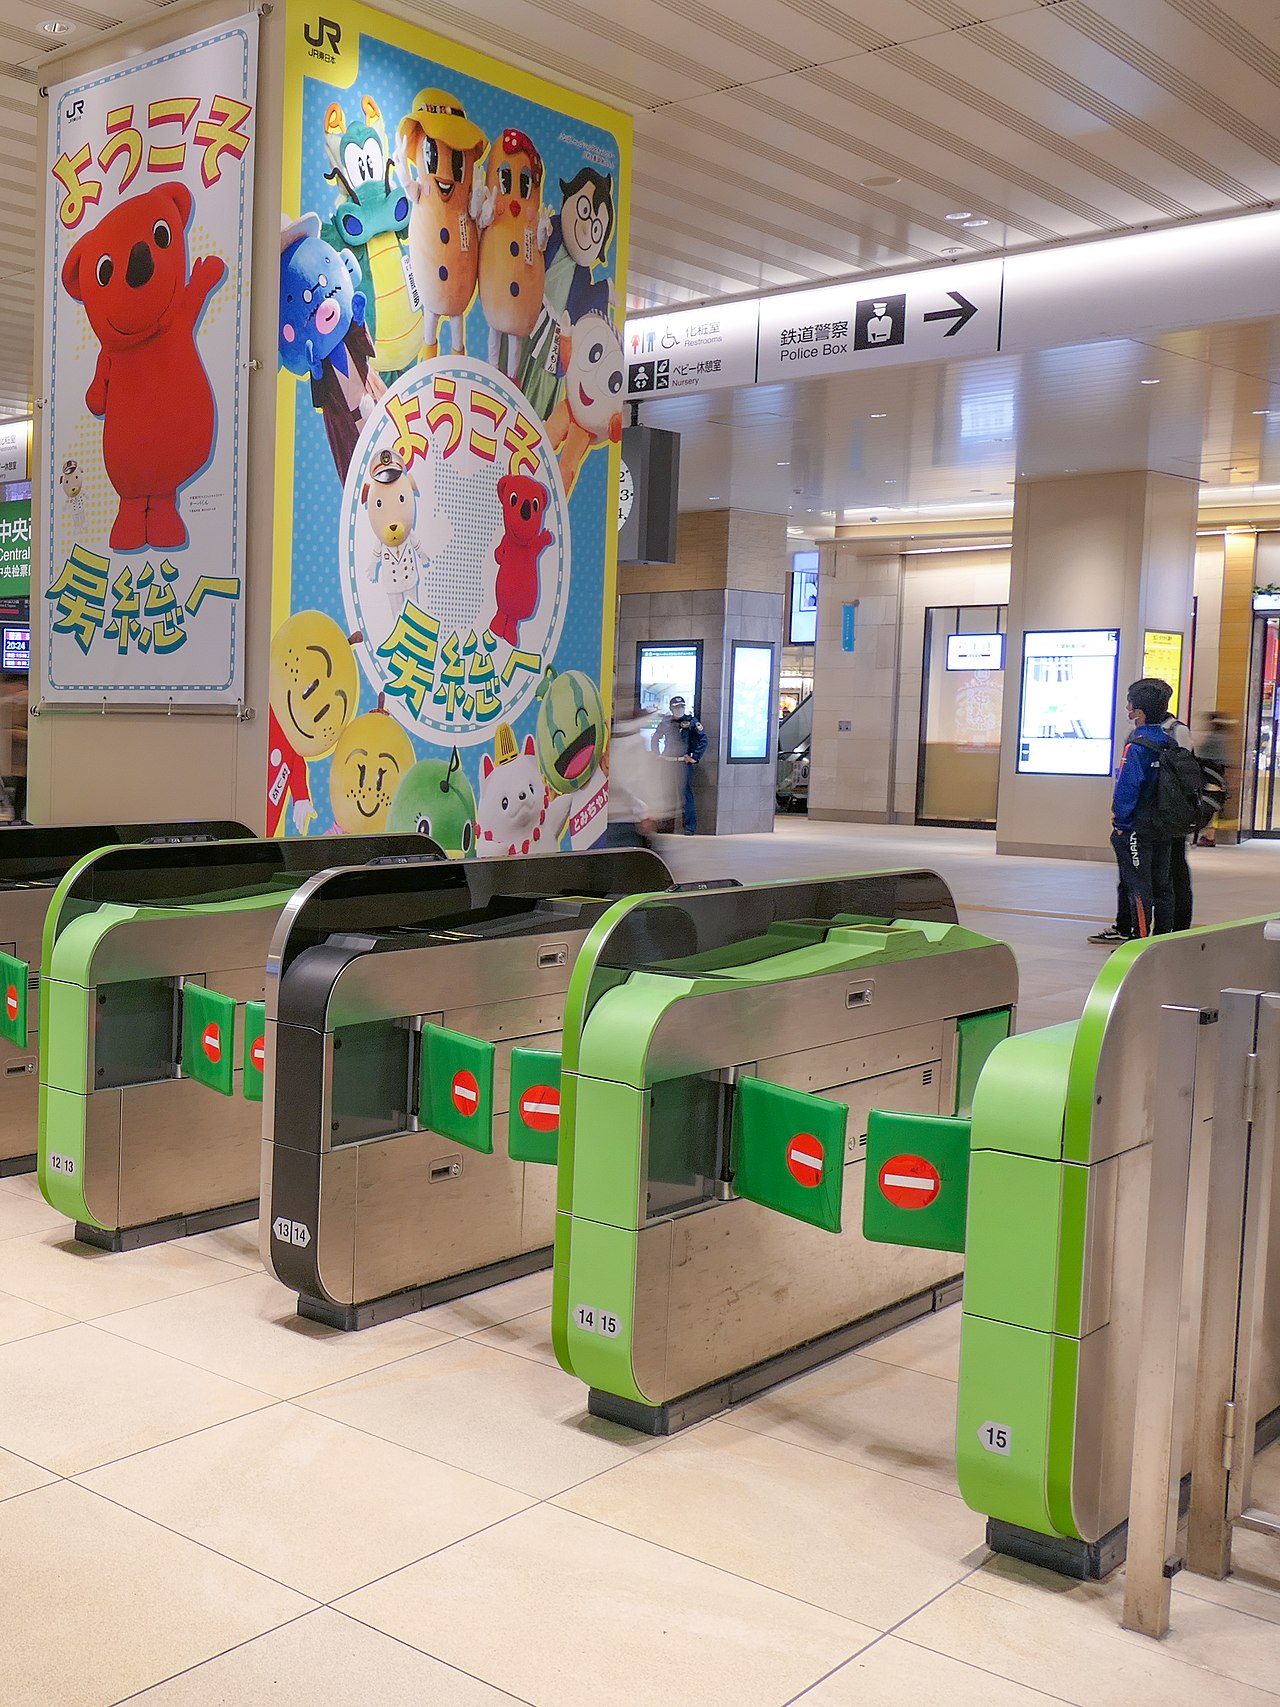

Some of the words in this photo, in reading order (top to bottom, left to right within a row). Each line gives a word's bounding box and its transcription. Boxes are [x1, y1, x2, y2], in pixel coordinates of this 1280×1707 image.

[303, 15, 341, 56] JR
[307, 48, 336, 64] JR東日本
[66, 99, 84, 119] JR
[52, 94, 252, 229] ようこそ
[685, 322, 720, 338] 化粧室
[780, 320, 848, 346] 鉄道警察
[684, 336, 722, 347] Restrooms
[780, 347, 818, 361] Police
[822, 343, 847, 355] Box
[672, 359, 722, 376] ベビー休憩室
[671, 378, 700, 387] Nursery
[384, 377, 542, 476] ようこそ
[619, 488, 630, 501] 3
[44, 543, 241, 657] 房総へ
[6, 641, 26, 650] 20:24
[376, 599, 542, 722] 房総へ
[574, 788, 608, 831] とみちゃん
[51, 1155, 61, 1169] 12
[64, 1159, 74, 1173] 13
[278, 1222, 289, 1237] 13
[295, 1227, 306, 1242] 14
[579, 1309, 594, 1327] 14
[601, 1315, 616, 1333] 15
[986, 1427, 1007, 1448] 15
